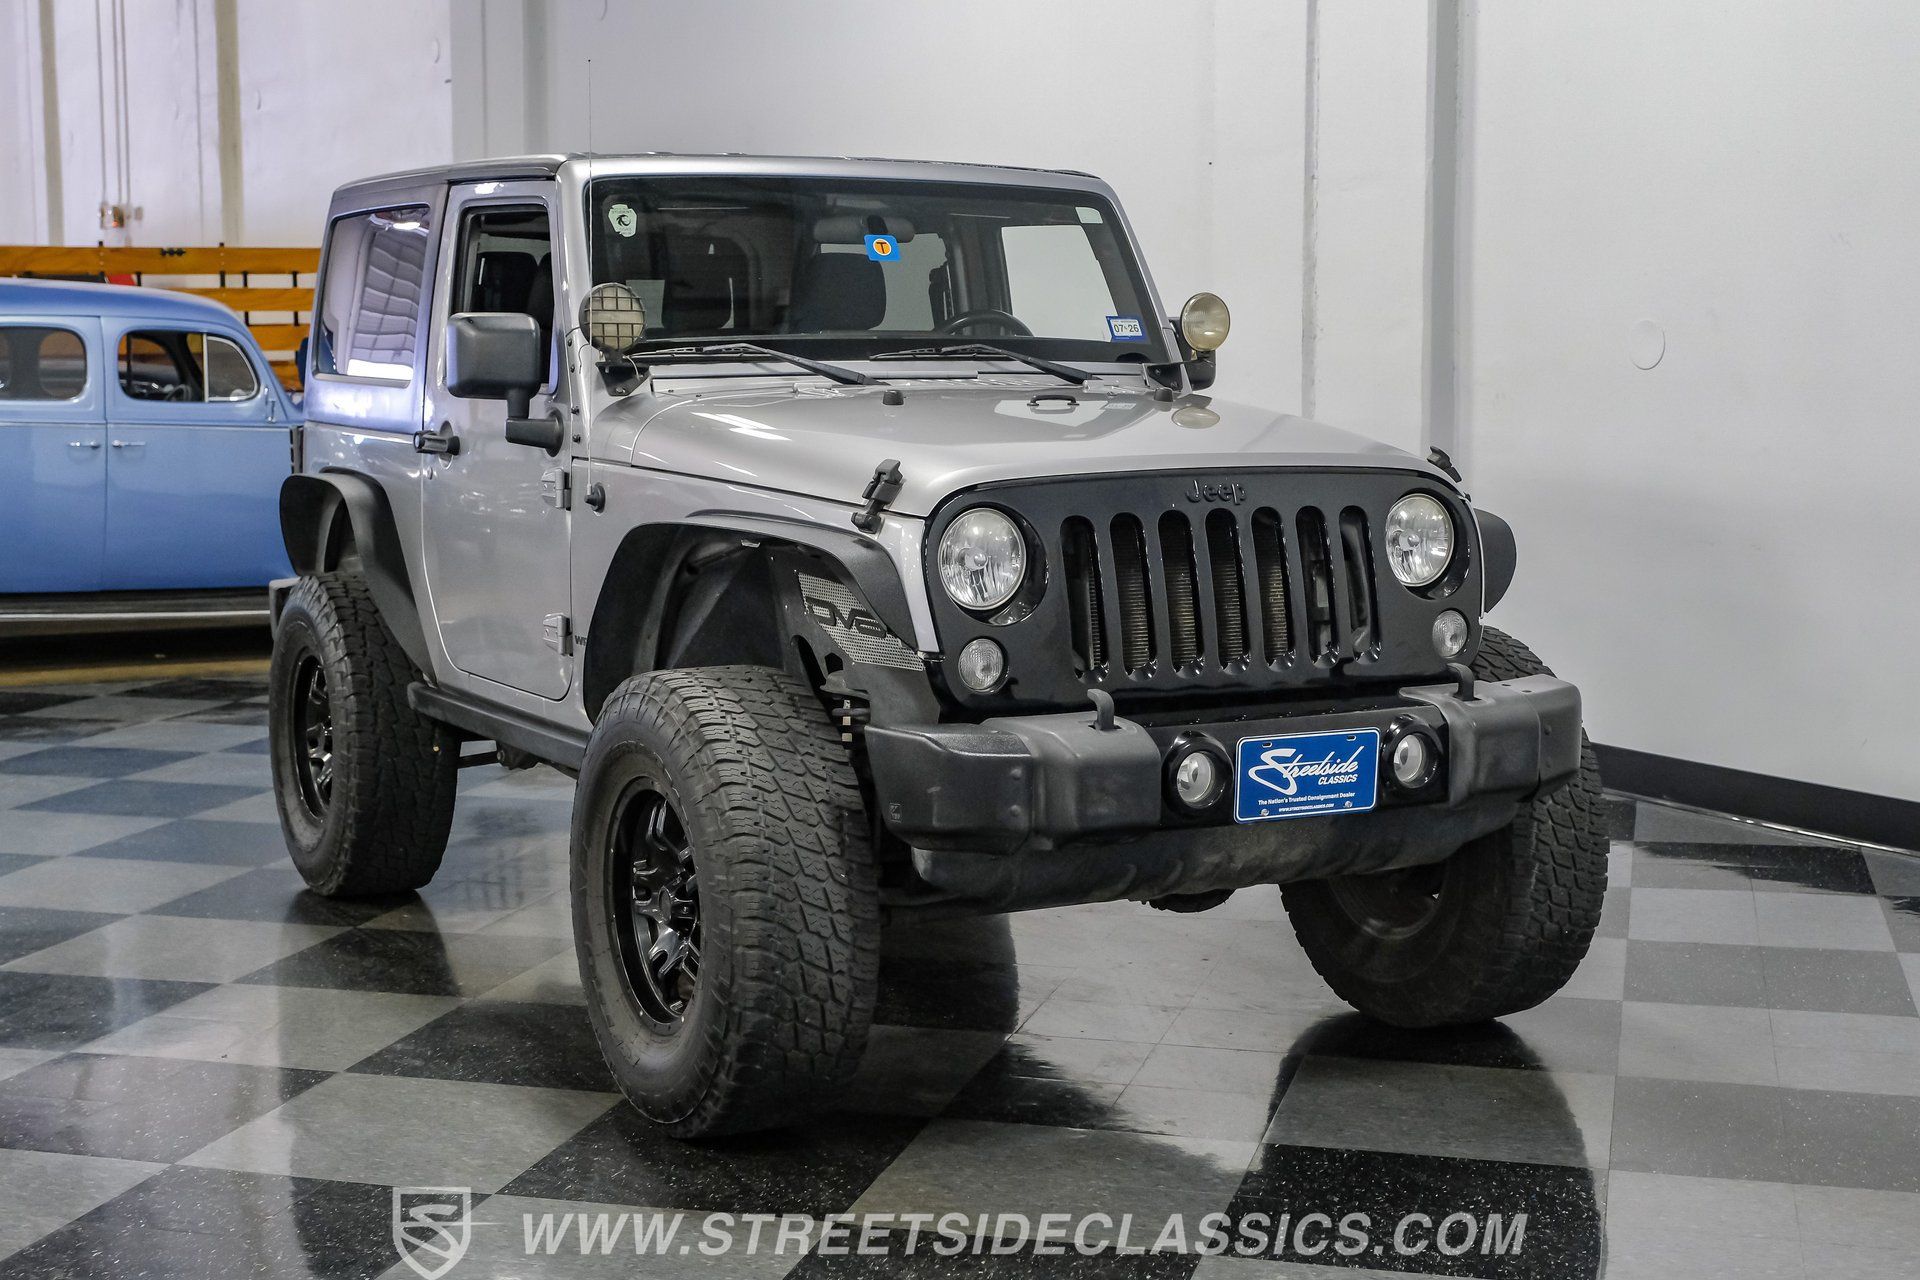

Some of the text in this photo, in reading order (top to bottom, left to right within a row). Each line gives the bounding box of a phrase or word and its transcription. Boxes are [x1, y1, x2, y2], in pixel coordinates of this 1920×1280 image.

[875, 241, 888, 254] T
[1114, 324, 1140, 332] 07 26
[1185, 479, 1247, 506] Jeep
[1248, 745, 1365, 796] Streetside
[1318, 774, 1358, 786] CLASSICS
